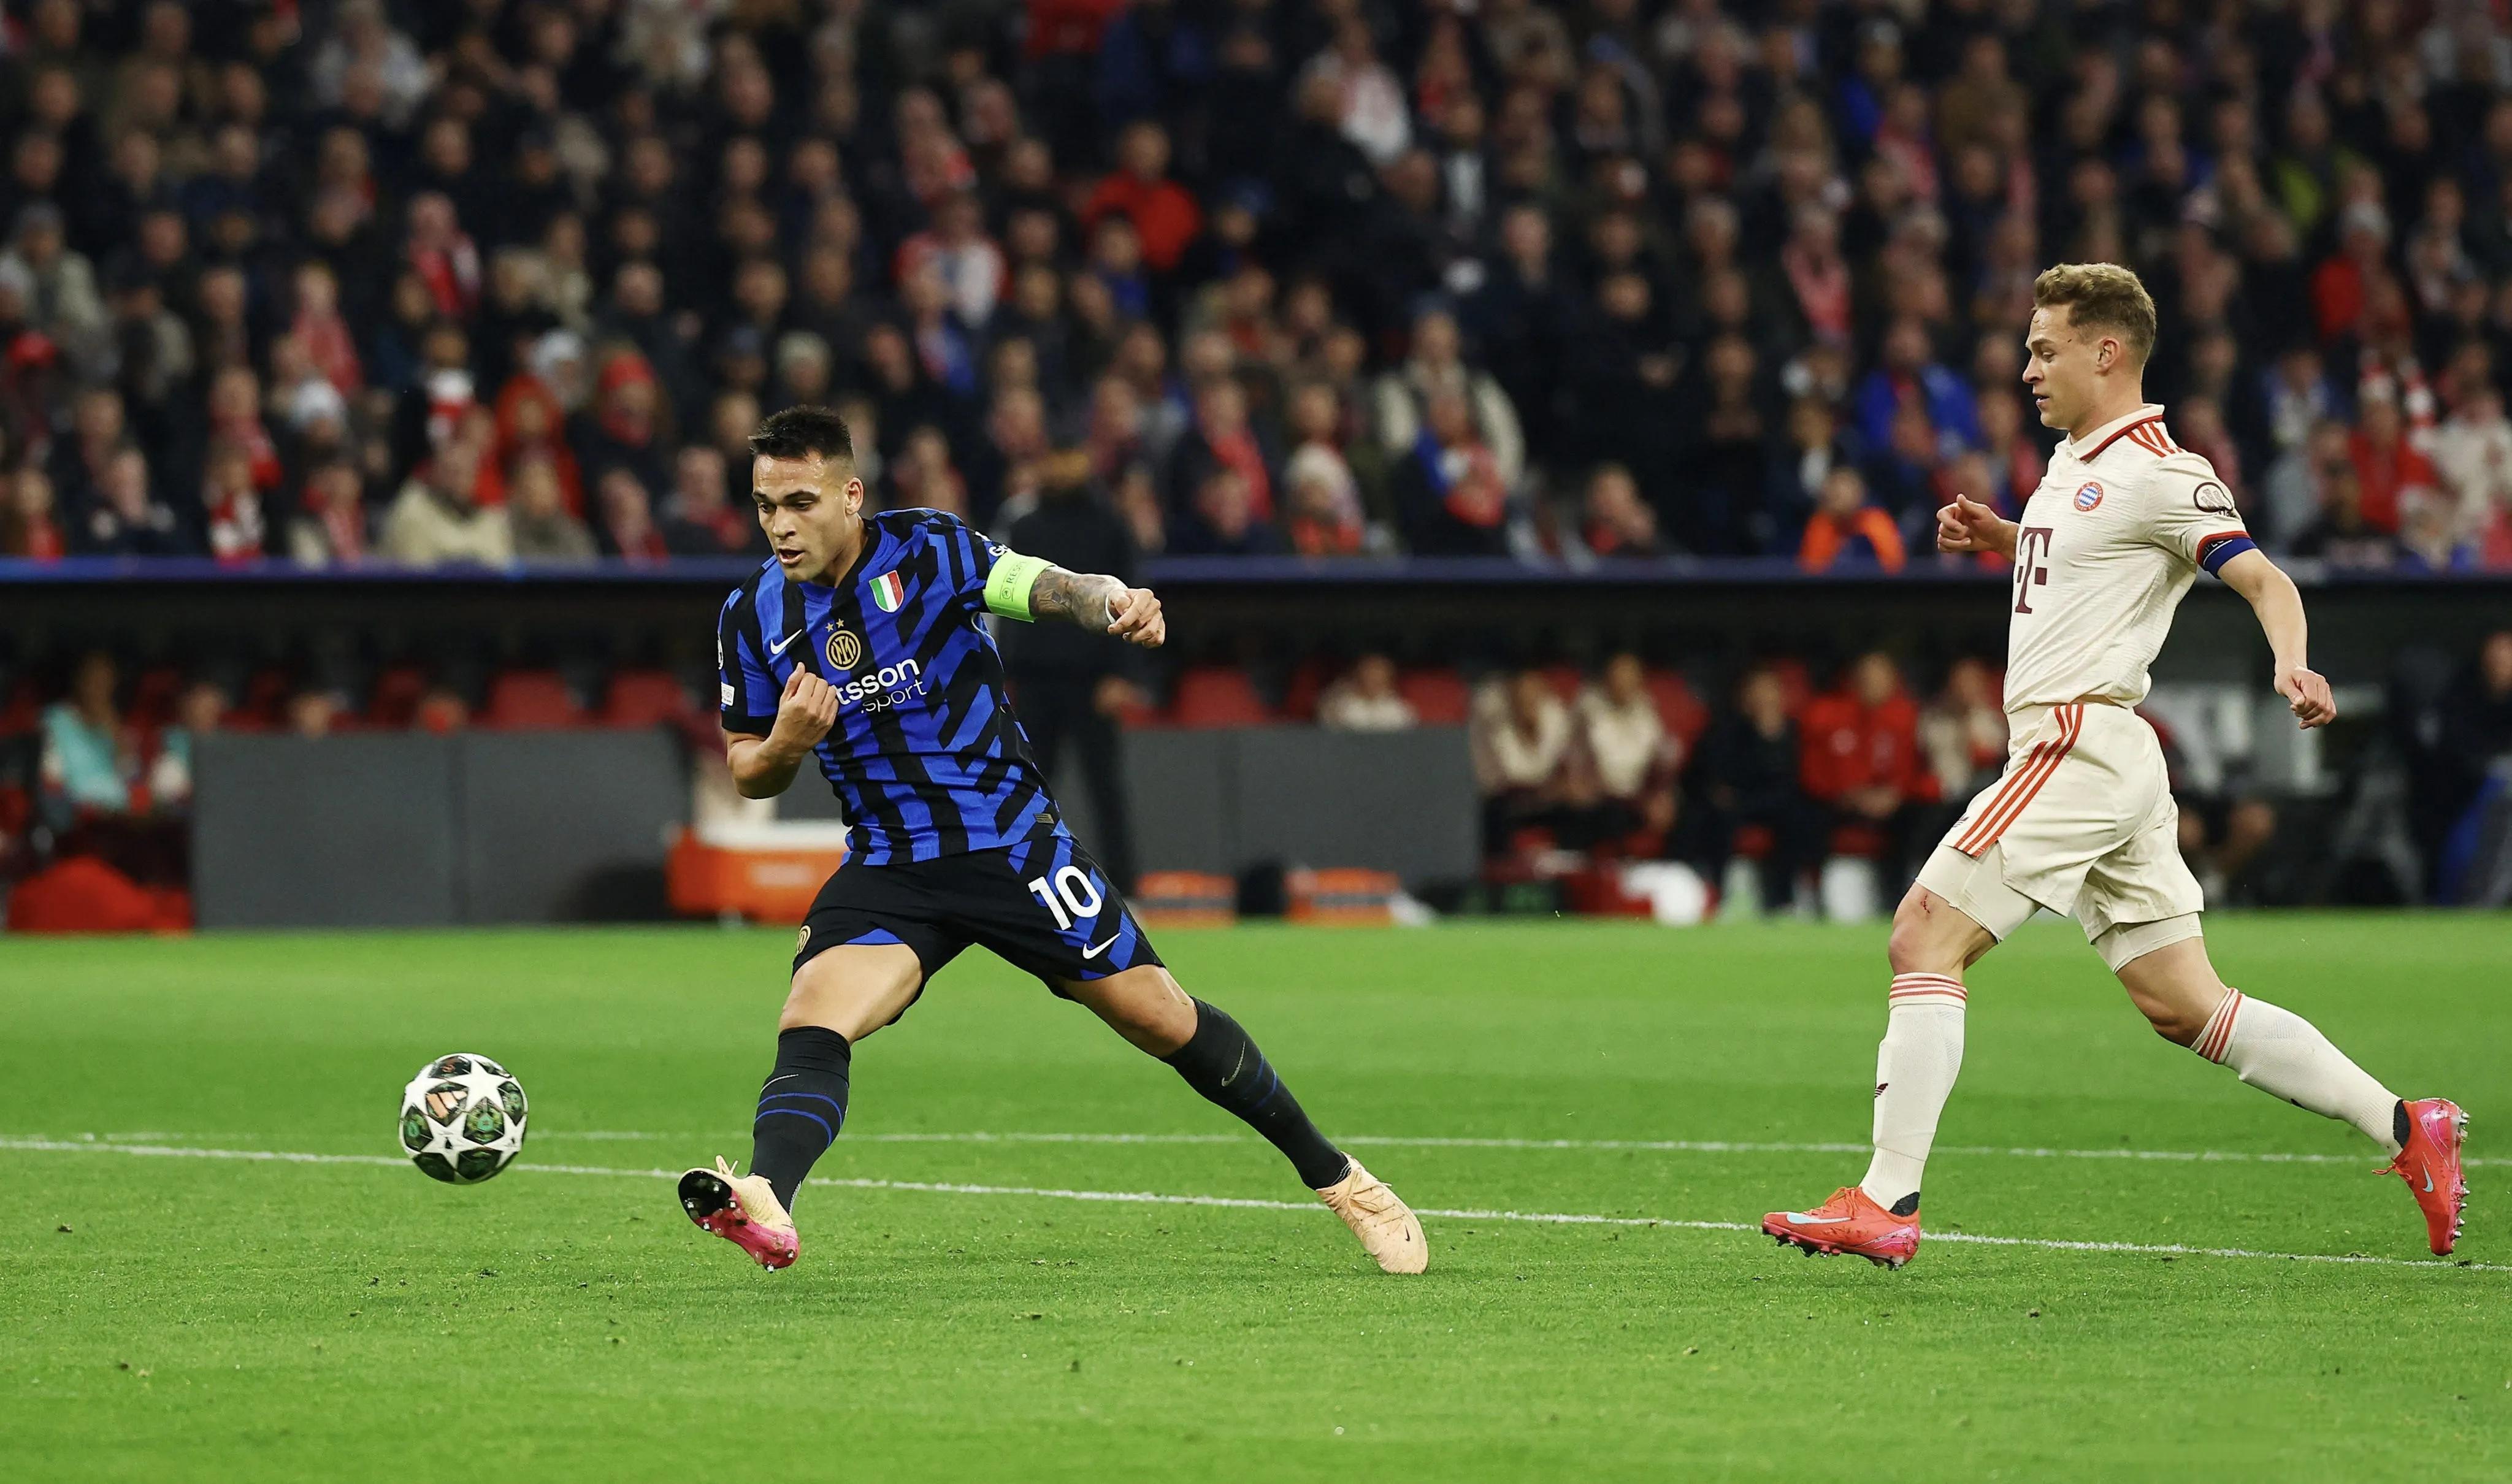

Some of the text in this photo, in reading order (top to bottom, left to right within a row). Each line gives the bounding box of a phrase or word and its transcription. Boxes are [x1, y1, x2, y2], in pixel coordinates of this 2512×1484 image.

[2015, 527, 2053, 614] T
[832, 659, 920, 705] tsson
[1028, 865, 1102, 931] 10
